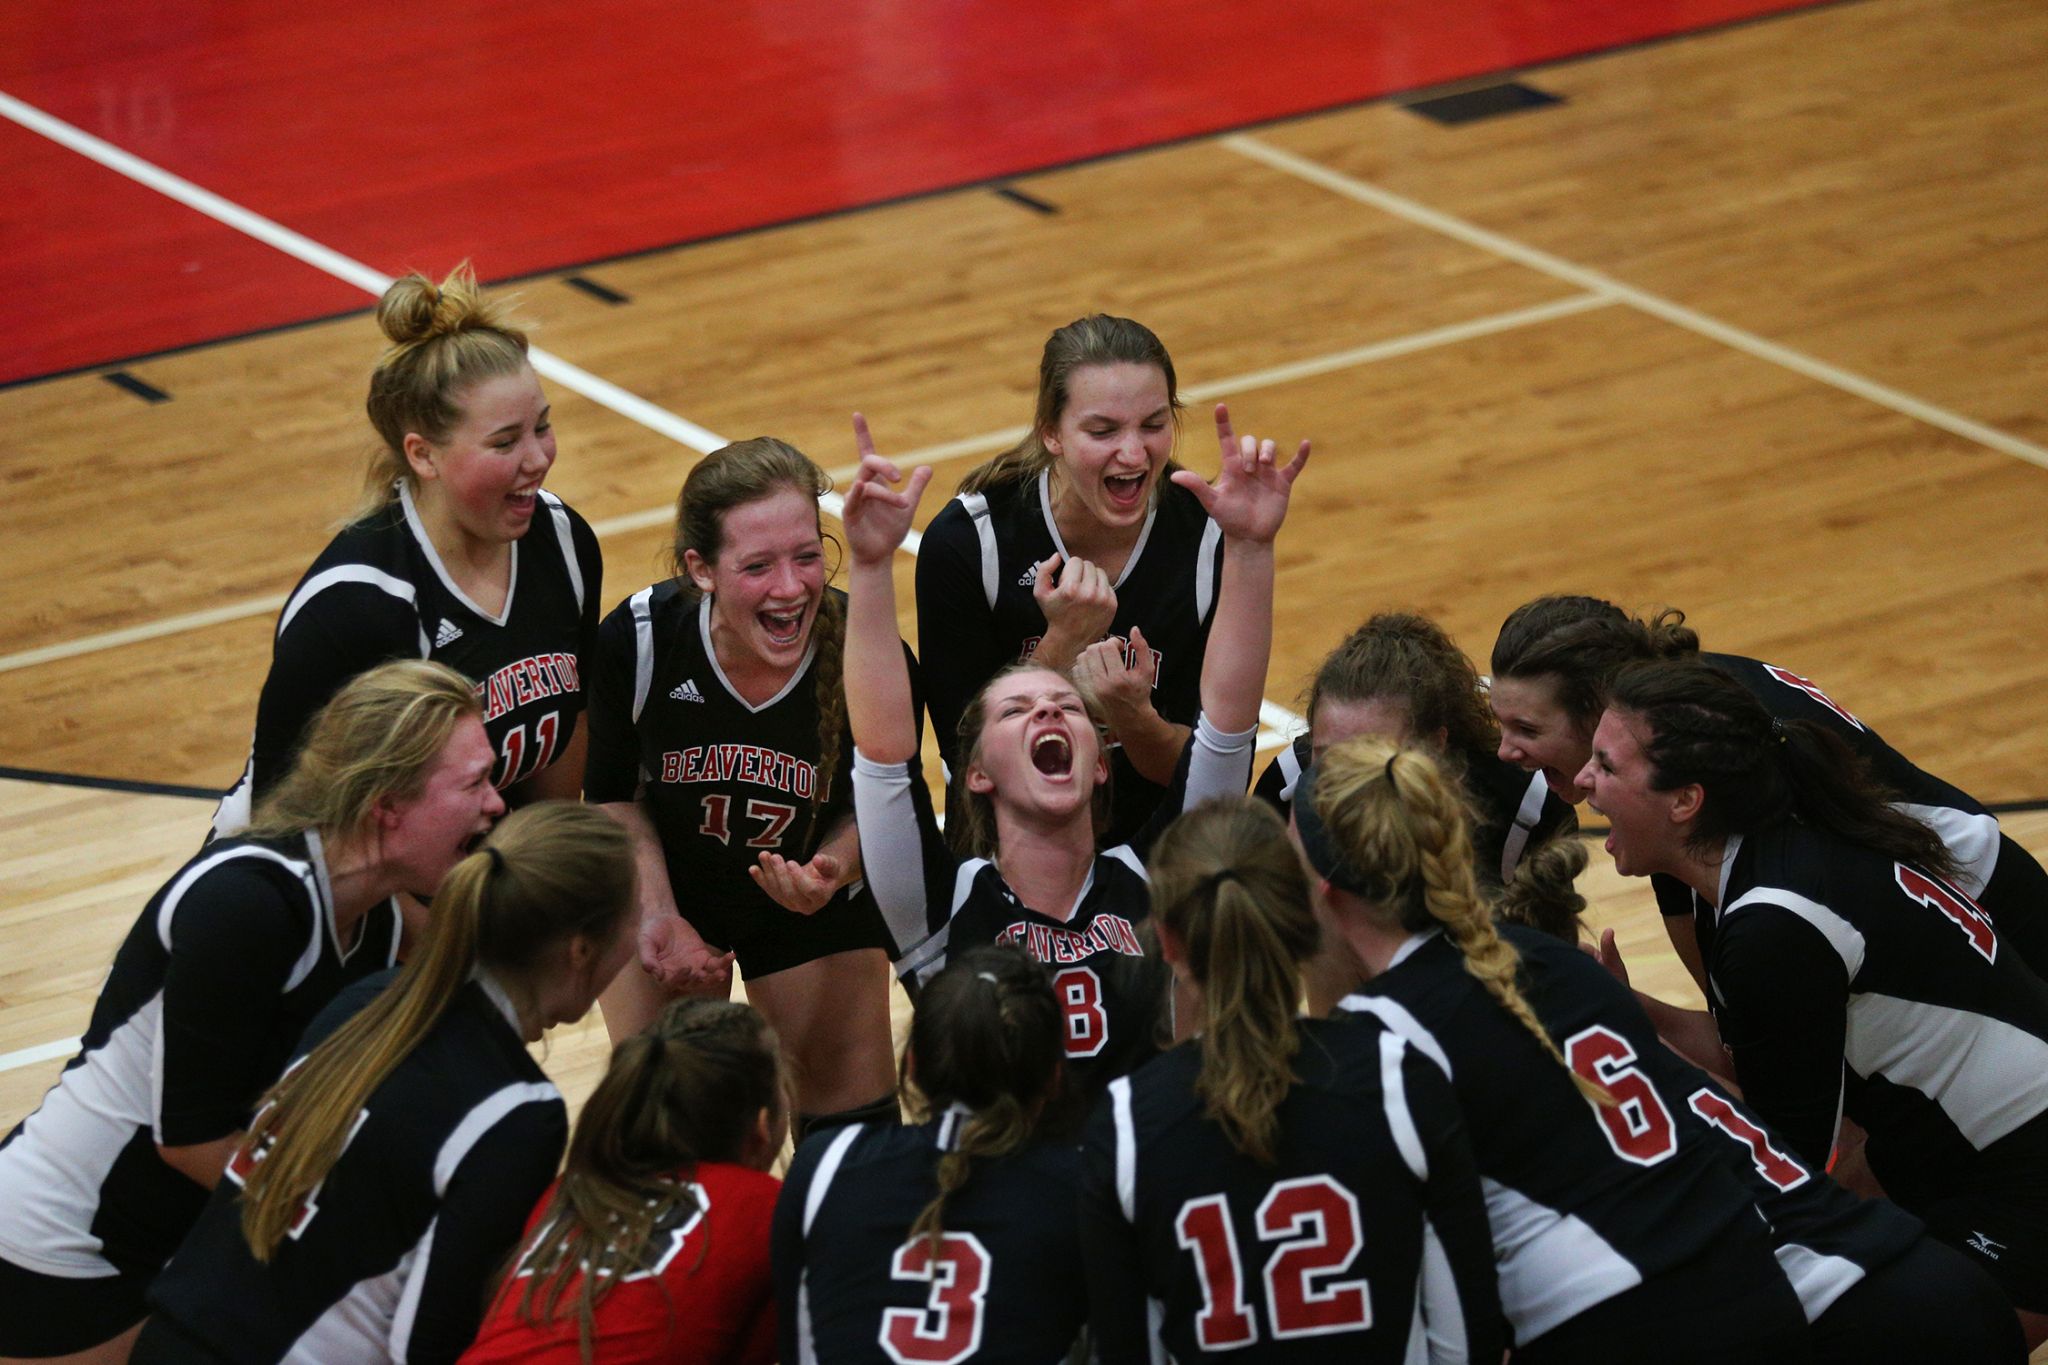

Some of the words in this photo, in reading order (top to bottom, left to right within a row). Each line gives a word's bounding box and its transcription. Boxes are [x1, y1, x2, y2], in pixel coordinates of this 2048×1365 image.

[435, 629, 463, 648] adidas
[473, 652, 581, 723] AVERTON
[669, 690, 705, 703] adidas
[496, 710, 560, 791] 11
[699, 793, 797, 848] 17
[1053, 966, 1109, 1059] 8
[1565, 1024, 1677, 1167] 6
[879, 1230, 991, 1365] 3
[1175, 1174, 1372, 1352] 12
